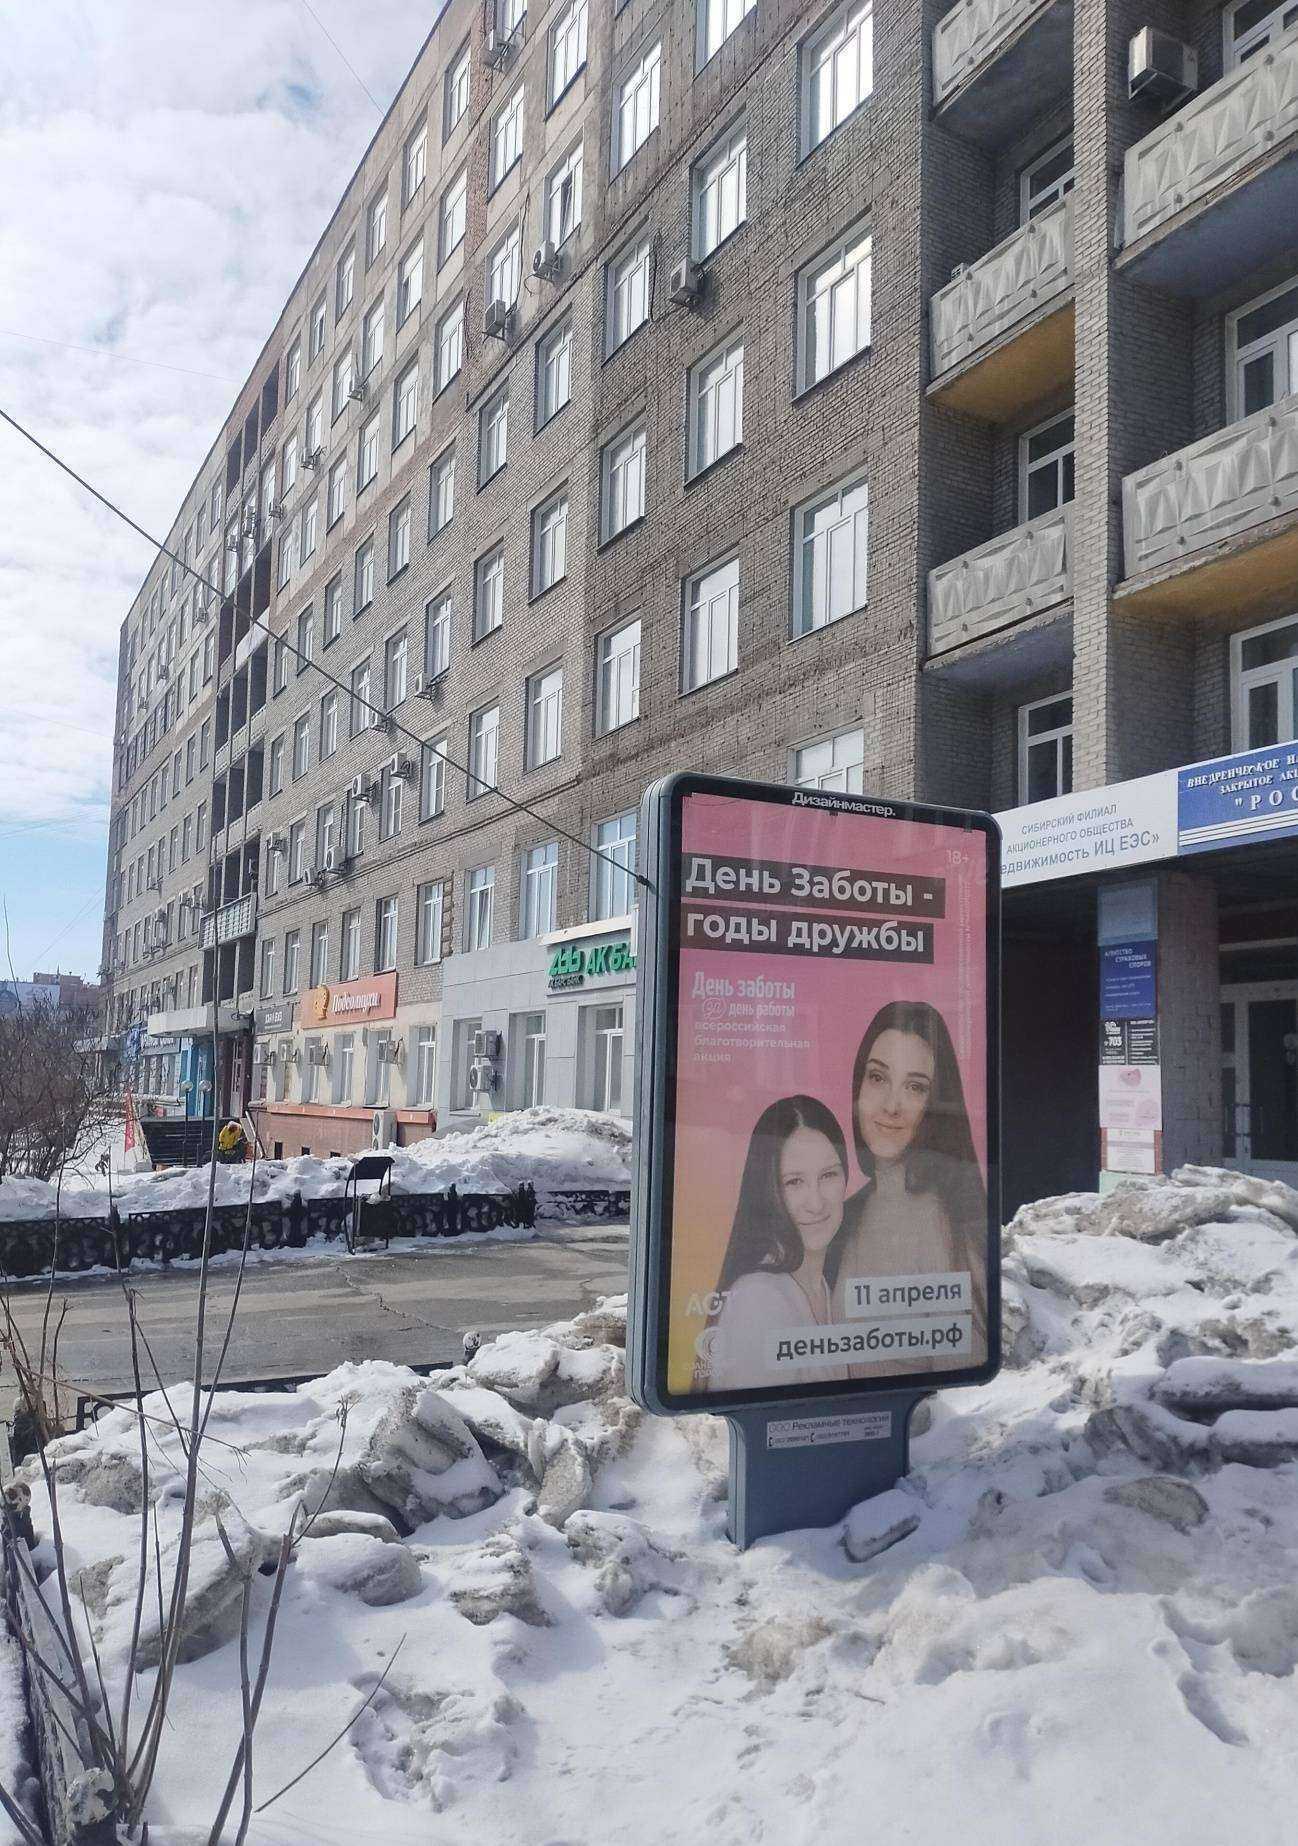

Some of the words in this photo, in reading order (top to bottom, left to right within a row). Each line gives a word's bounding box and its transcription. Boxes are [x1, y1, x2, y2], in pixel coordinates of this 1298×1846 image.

[1220, 775, 1273, 795] ЗАКРЫТОЕ
[792, 791, 896, 818] Дизайнмастер.
[1021, 813, 1075, 835] СИБИРСКИЙ
[1077, 804, 1117, 822] ФИЛИАЛ
[1007, 831, 1077, 854] АКЦИОНЕРНОГО
[1079, 818, 1134, 838] ОБЩЕСТВА
[1001, 848, 1089, 875] едвижимость
[1095, 838, 1114, 856] ИЦ
[685, 857, 781, 894] День
[790, 867, 912, 906] Заботы
[686, 913, 777, 944] годы
[788, 921, 923, 953] дружбы
[692, 972, 735, 999] День
[736, 975, 796, 999] заботы
[728, 1002, 754, 1017] день
[756, 1001, 796, 1019] работы
[854, 1284, 871, 1305] 11
[879, 1283, 961, 1307] апреля
[777, 1322, 962, 1361] деньзаботы.рф
